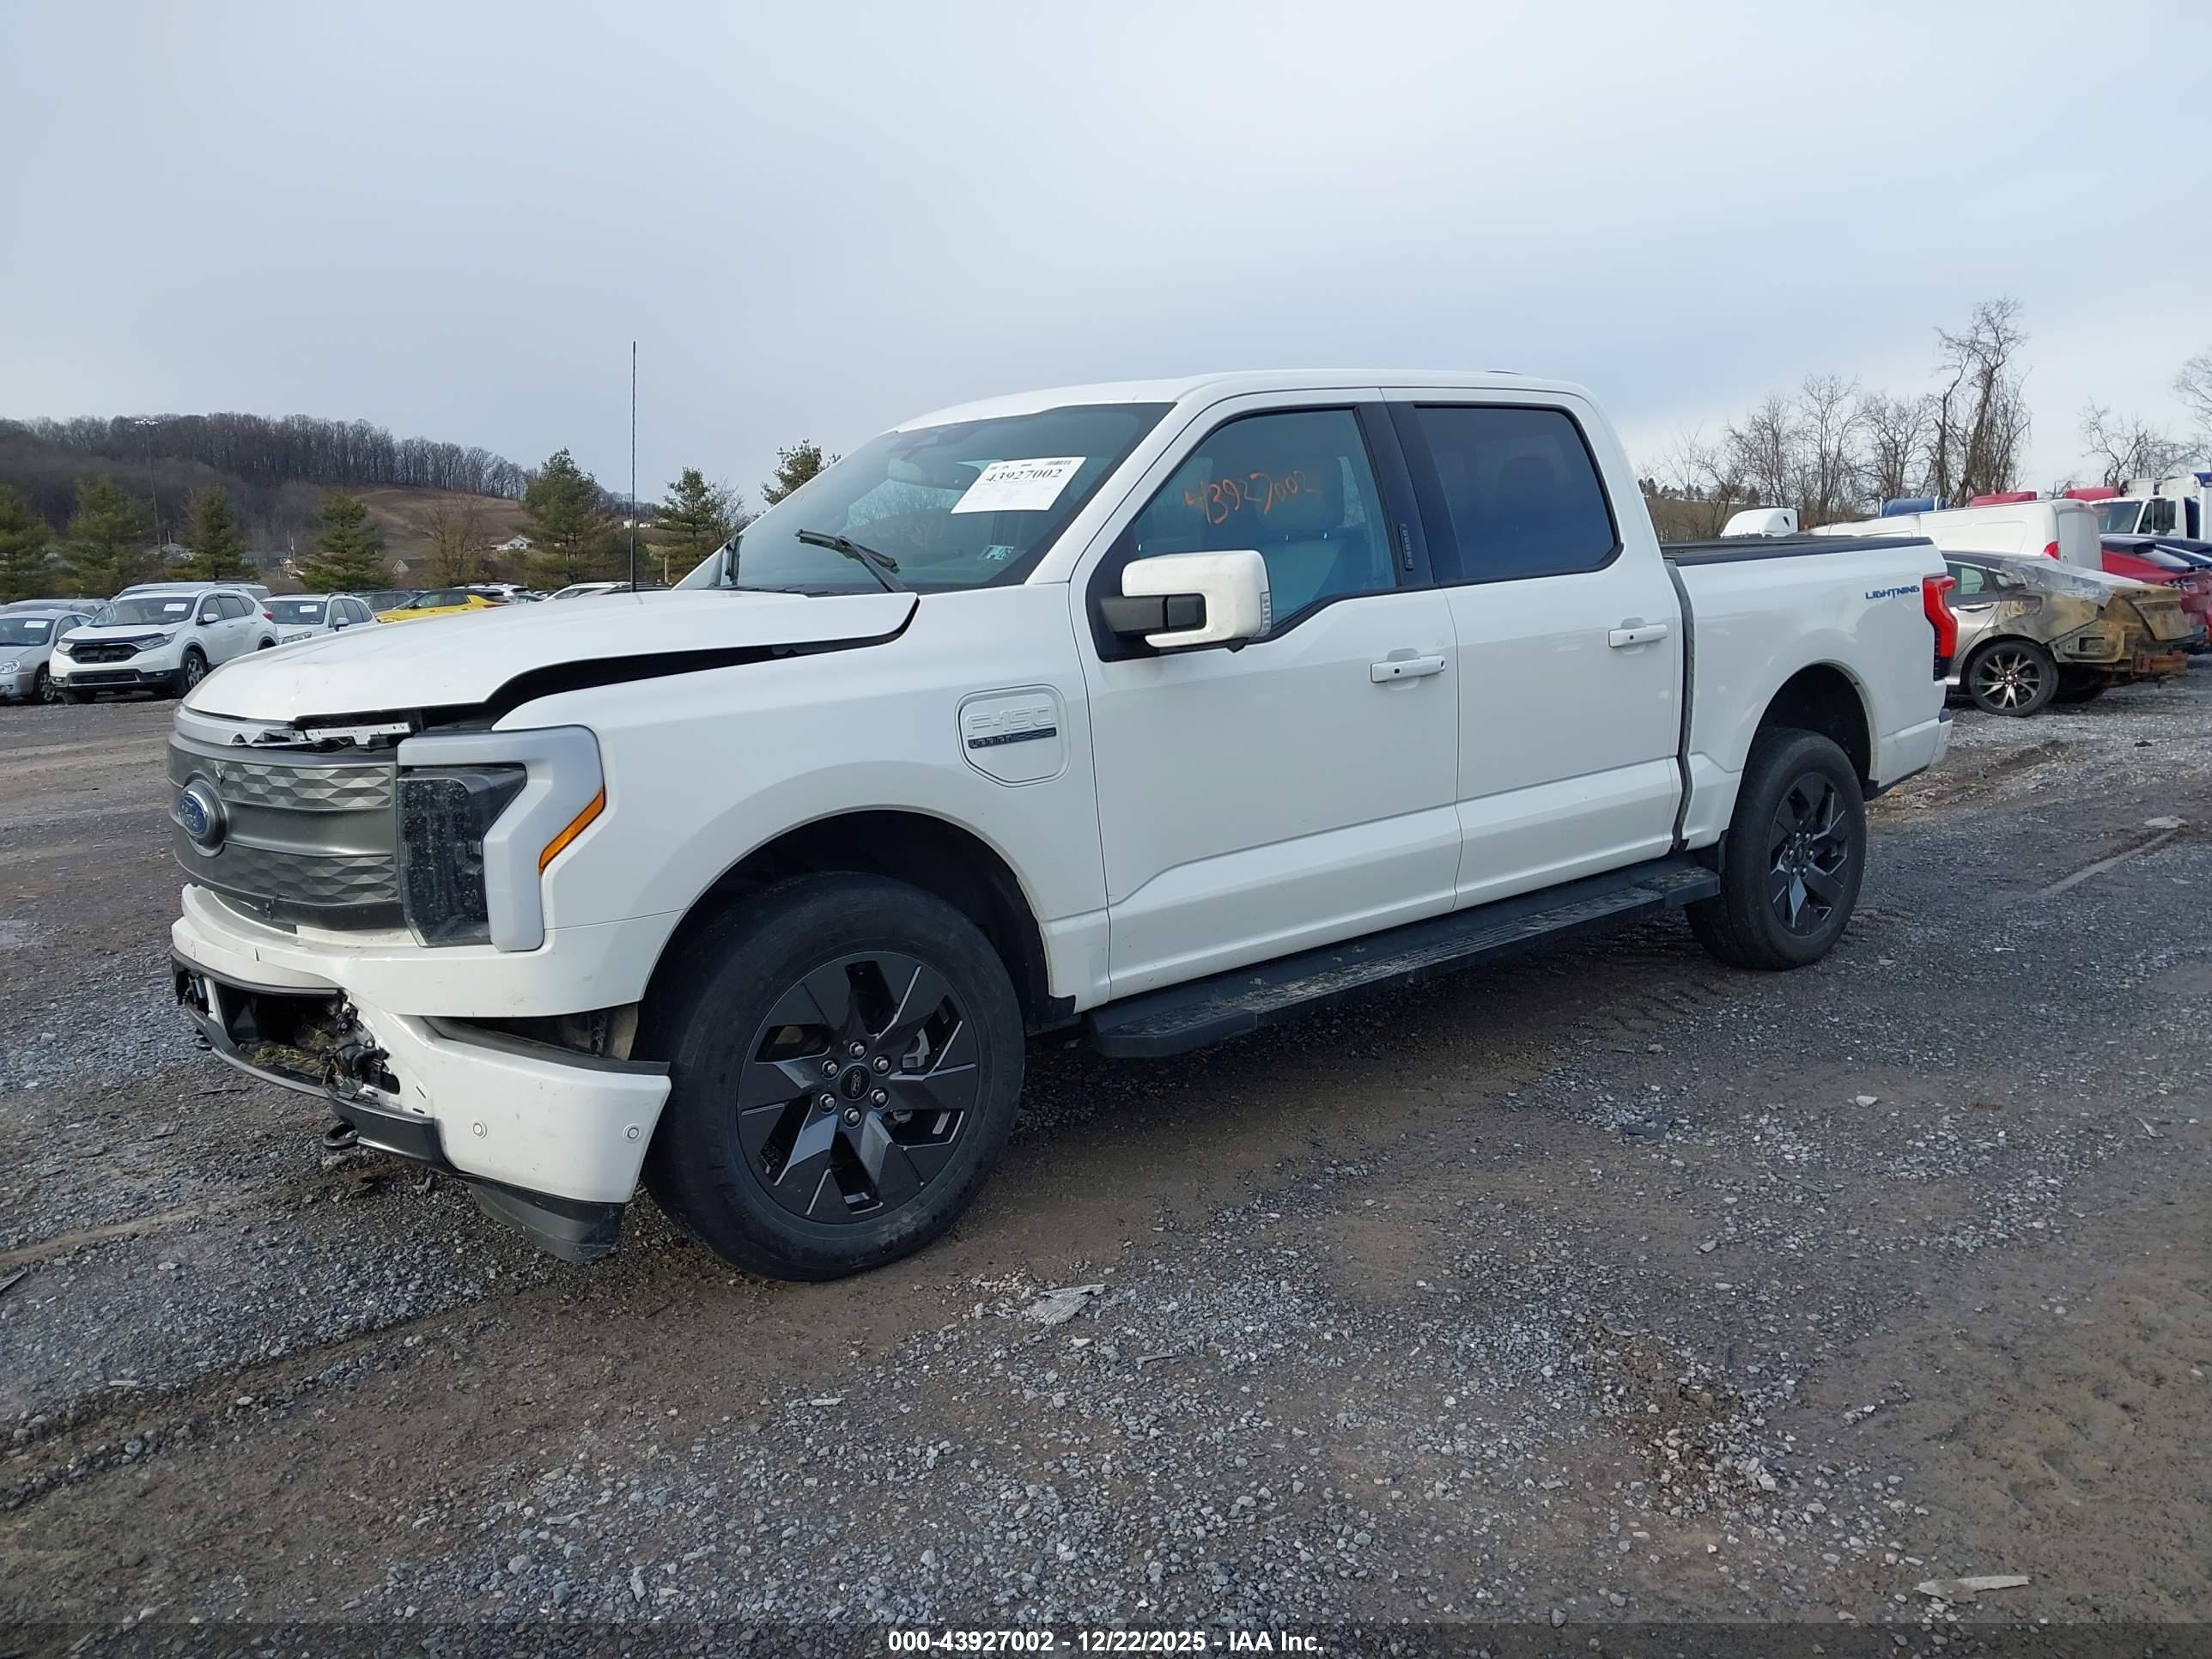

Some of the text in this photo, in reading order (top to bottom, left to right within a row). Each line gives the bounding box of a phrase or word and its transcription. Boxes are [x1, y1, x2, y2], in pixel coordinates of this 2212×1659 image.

[985, 468, 1063, 483] 43927002
[1865, 585, 1920, 599] LIGHTNING
[964, 704, 1056, 738] F-150
